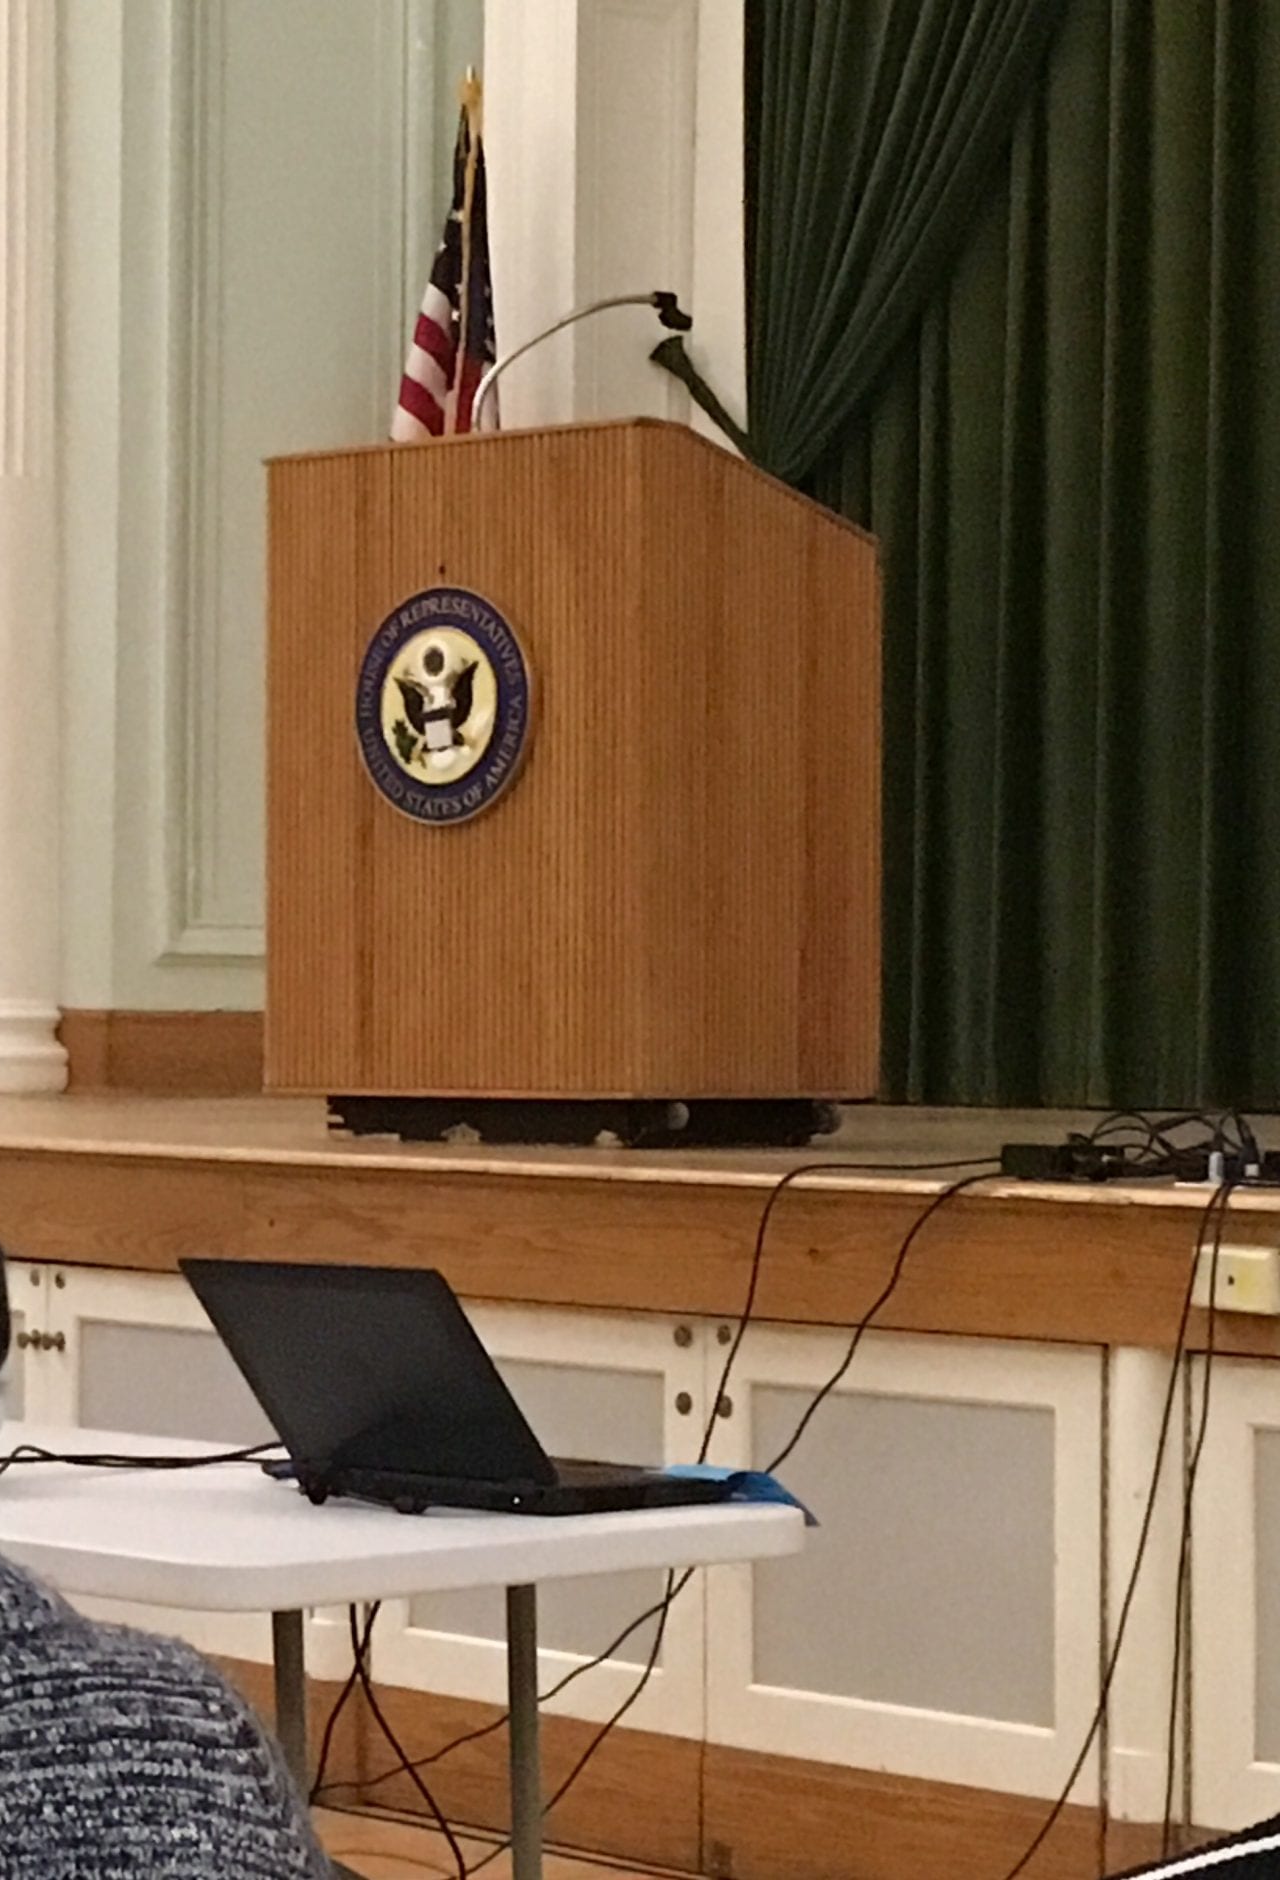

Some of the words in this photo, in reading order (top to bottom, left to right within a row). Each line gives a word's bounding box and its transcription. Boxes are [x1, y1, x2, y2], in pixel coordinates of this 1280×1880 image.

[381, 620, 400, 645] OF
[399, 596, 521, 686] REPRESENTATIVES
[404, 791, 462, 816] STATES
[463, 782, 483, 808] OF
[485, 695, 523, 790] AMERICA
